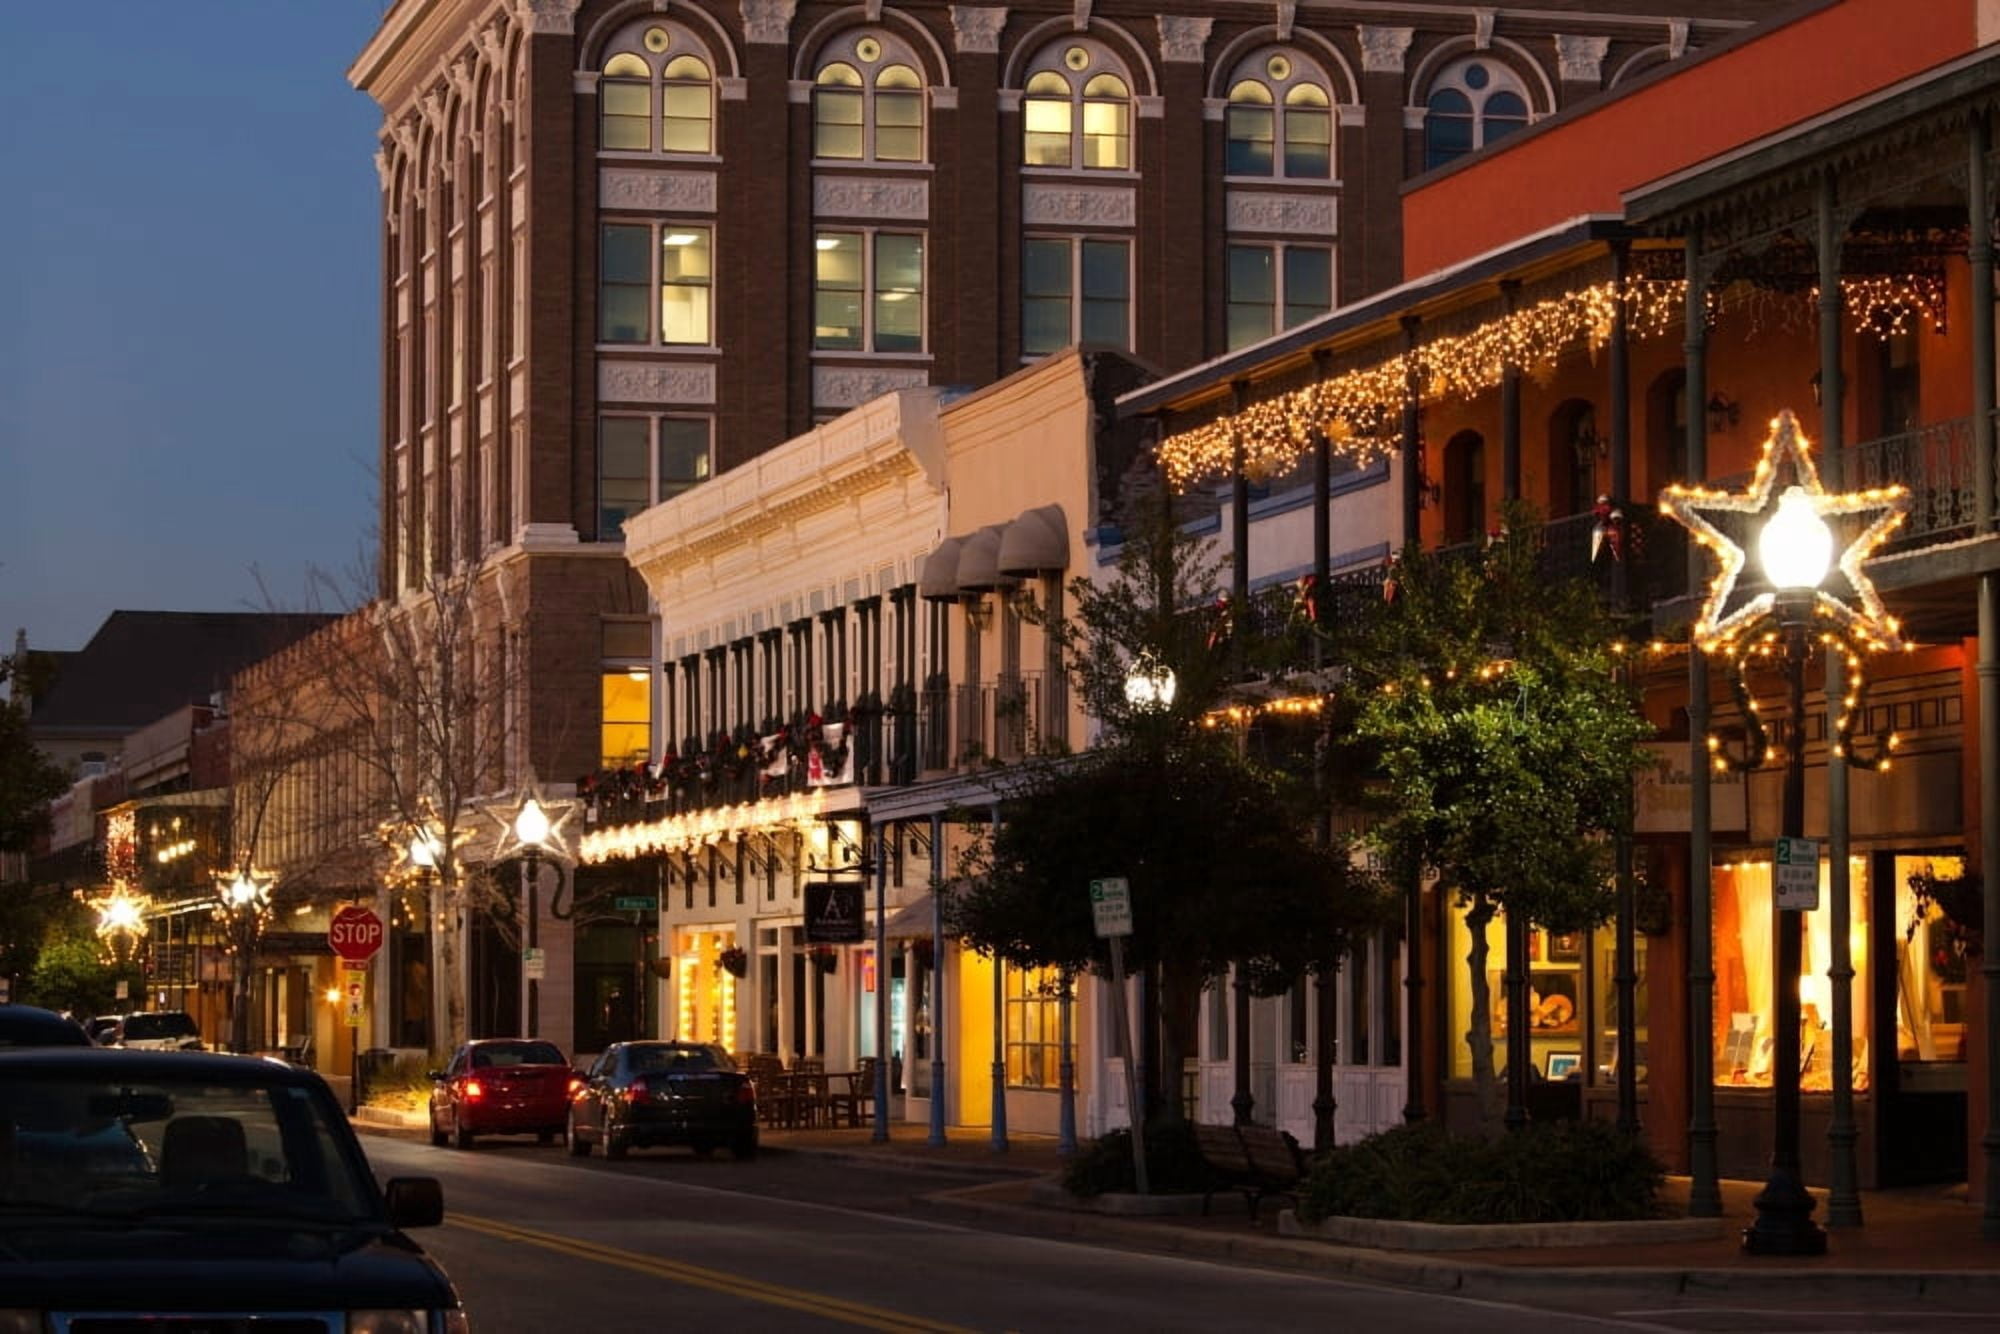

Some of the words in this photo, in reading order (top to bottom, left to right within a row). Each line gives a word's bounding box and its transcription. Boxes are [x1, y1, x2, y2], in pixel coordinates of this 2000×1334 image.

[1779, 842, 1788, 861] 2
[1091, 882, 1102, 897] 2
[333, 923, 381, 944] STOP
